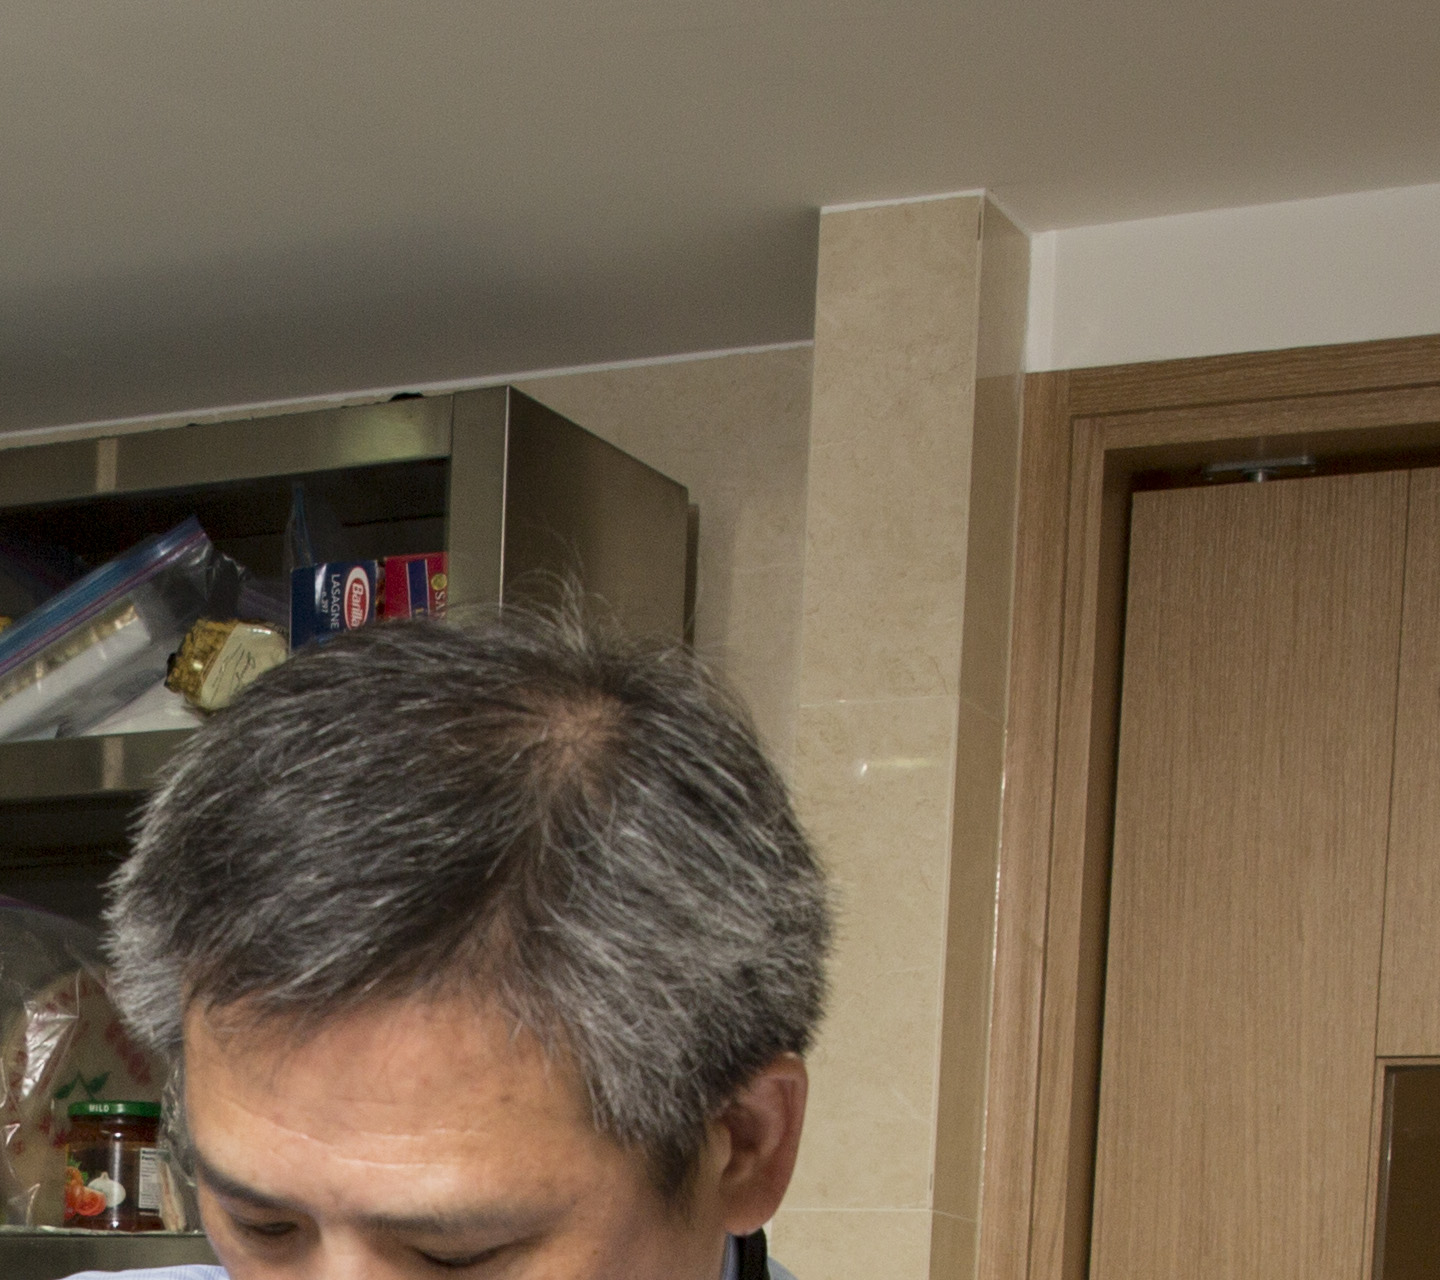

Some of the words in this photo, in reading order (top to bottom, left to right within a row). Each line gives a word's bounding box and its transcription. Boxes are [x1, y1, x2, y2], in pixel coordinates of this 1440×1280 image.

[330, 573, 340, 630] LASAGNE
[351, 582, 365, 628] Barilla
[89, 1104, 109, 1112] MILD
